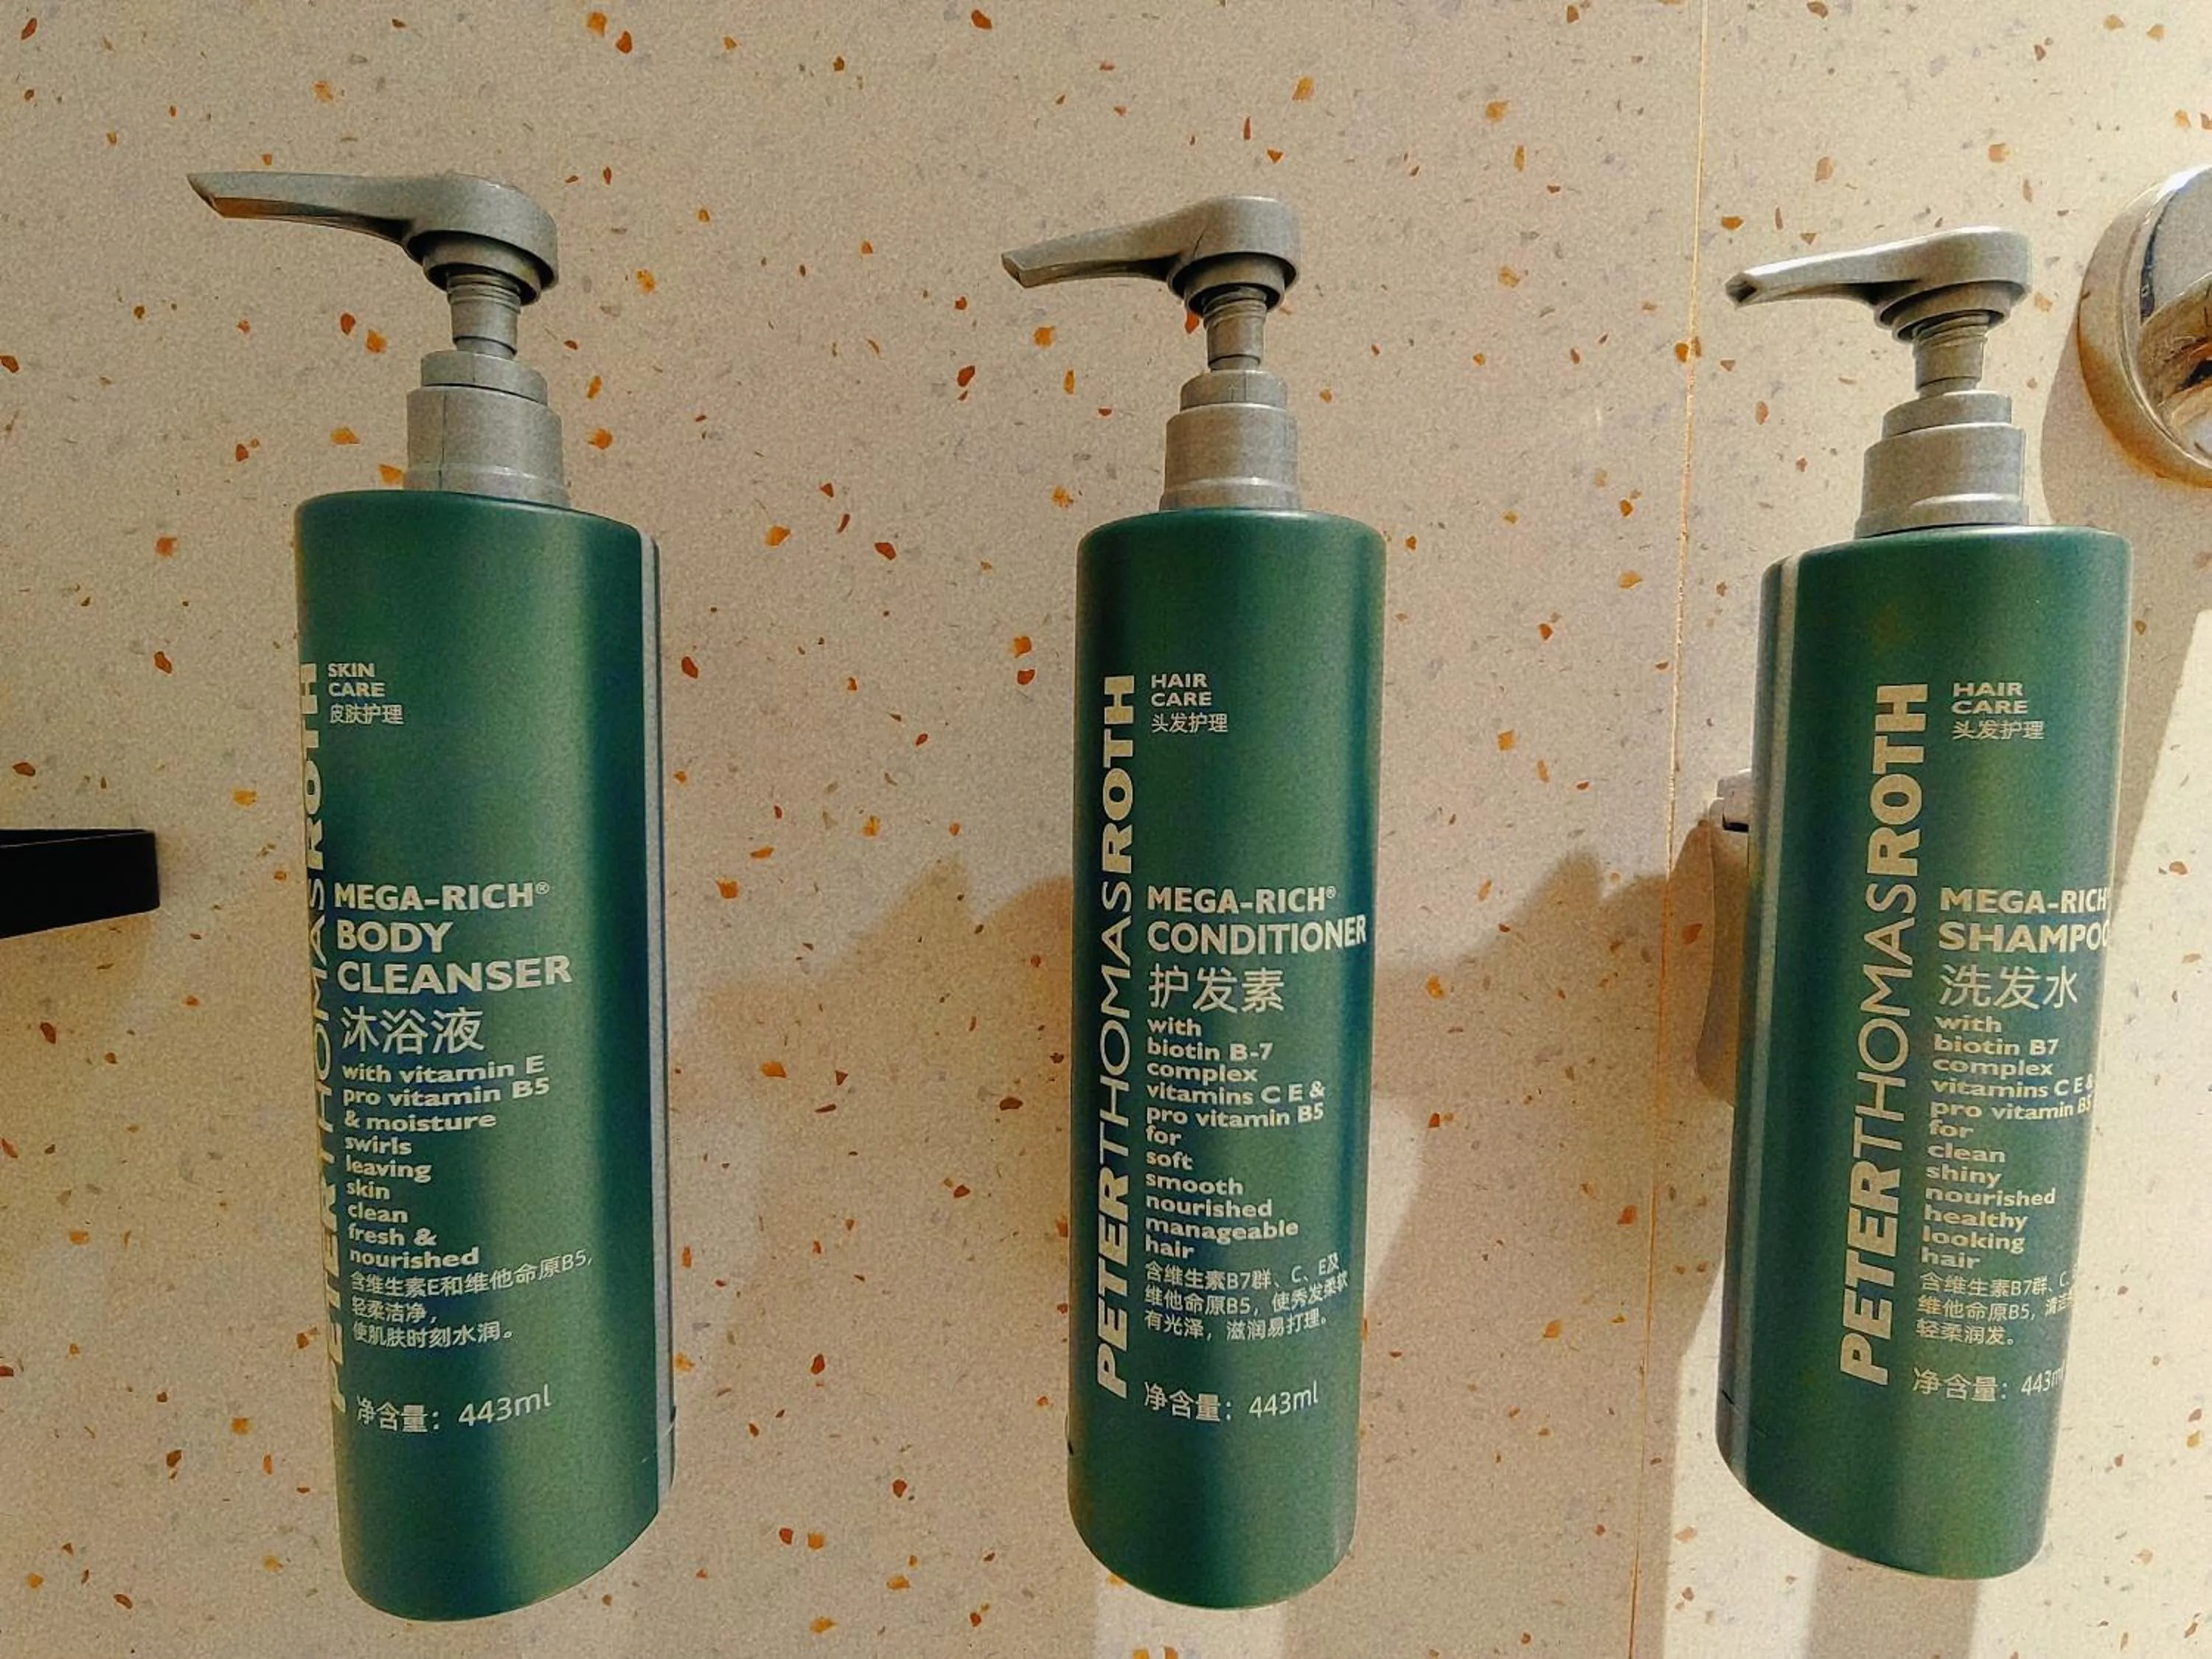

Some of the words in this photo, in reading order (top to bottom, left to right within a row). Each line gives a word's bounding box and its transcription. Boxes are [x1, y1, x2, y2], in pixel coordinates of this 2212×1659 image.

[328, 663, 375, 678] SKIN
[1151, 673, 1208, 688] HAIR
[328, 682, 385, 697] CARE
[1151, 691, 1212, 707] CARE
[1953, 682, 2023, 698] HAIR
[330, 703, 404, 725] 皮肤护理
[1952, 700, 2029, 715] CARE
[1151, 712, 1228, 734] 头发护理
[1952, 720, 2045, 740] 头发护理
[337, 919, 454, 953] BODY
[1147, 914, 1367, 956] CONDITIONER
[337, 955, 573, 995] CLEANSER
[1148, 962, 1285, 1015] 护发素
[1938, 964, 2078, 1010] 洗发水
[341, 1006, 484, 1055] 沐浴液
[1147, 1017, 1202, 1037] with
[1935, 1015, 2002, 1033] with
[1147, 1037, 1220, 1061] biotin
[1230, 1042, 1273, 1062] B-7
[1934, 1033, 2020, 1057] biotin
[2030, 1038, 2059, 1056] B7
[342, 1063, 392, 1084] with
[400, 1062, 514, 1084] vitamin
[526, 1055, 545, 1075] E
[1147, 1062, 1259, 1085] complex
[1933, 1057, 2053, 1079] complex
[343, 1088, 380, 1107] pro
[389, 1086, 501, 1107] vitamin
[512, 1078, 549, 1099] B5
[1147, 1082, 1253, 1106] vitamins
[1261, 1086, 1281, 1103] C
[1288, 1084, 1303, 1102] E
[1309, 1080, 1326, 1099] &
[1930, 1079, 2048, 1099] vitamins
[2053, 1079, 2070, 1096] C
[2073, 1076, 2084, 1094] E
[344, 1110, 359, 1128] &
[366, 1112, 496, 1133] moisture
[1146, 1106, 1188, 1126] pro
[1195, 1108, 1290, 1128] vitamin
[1297, 1103, 1324, 1124] B5
[1930, 1102, 1982, 1120] pro
[1992, 1101, 2074, 1121] vitamin
[1145, 1125, 1182, 1147] for
[1929, 1119, 1974, 1138] for
[345, 1135, 412, 1156] swirls
[1927, 1142, 2006, 1164] clean
[346, 1155, 432, 1183] leaving
[1146, 1152, 1194, 1171] soft
[1146, 1173, 1244, 1196] smooth
[1926, 1163, 2002, 1189] shiny
[347, 1179, 390, 1201] skin
[1925, 1187, 2056, 1208] nourished
[347, 1203, 408, 1223] clean
[1146, 1195, 1272, 1218] nourished
[1923, 1203, 2029, 1234] healthy
[348, 1223, 405, 1246] fresh
[414, 1228, 437, 1246] &
[1145, 1216, 1298, 1245] manageable
[1922, 1225, 2025, 1253] looking
[1145, 1234, 1195, 1259] hair
[1920, 1246, 1981, 1269] hair
[349, 1247, 479, 1270] nourished
